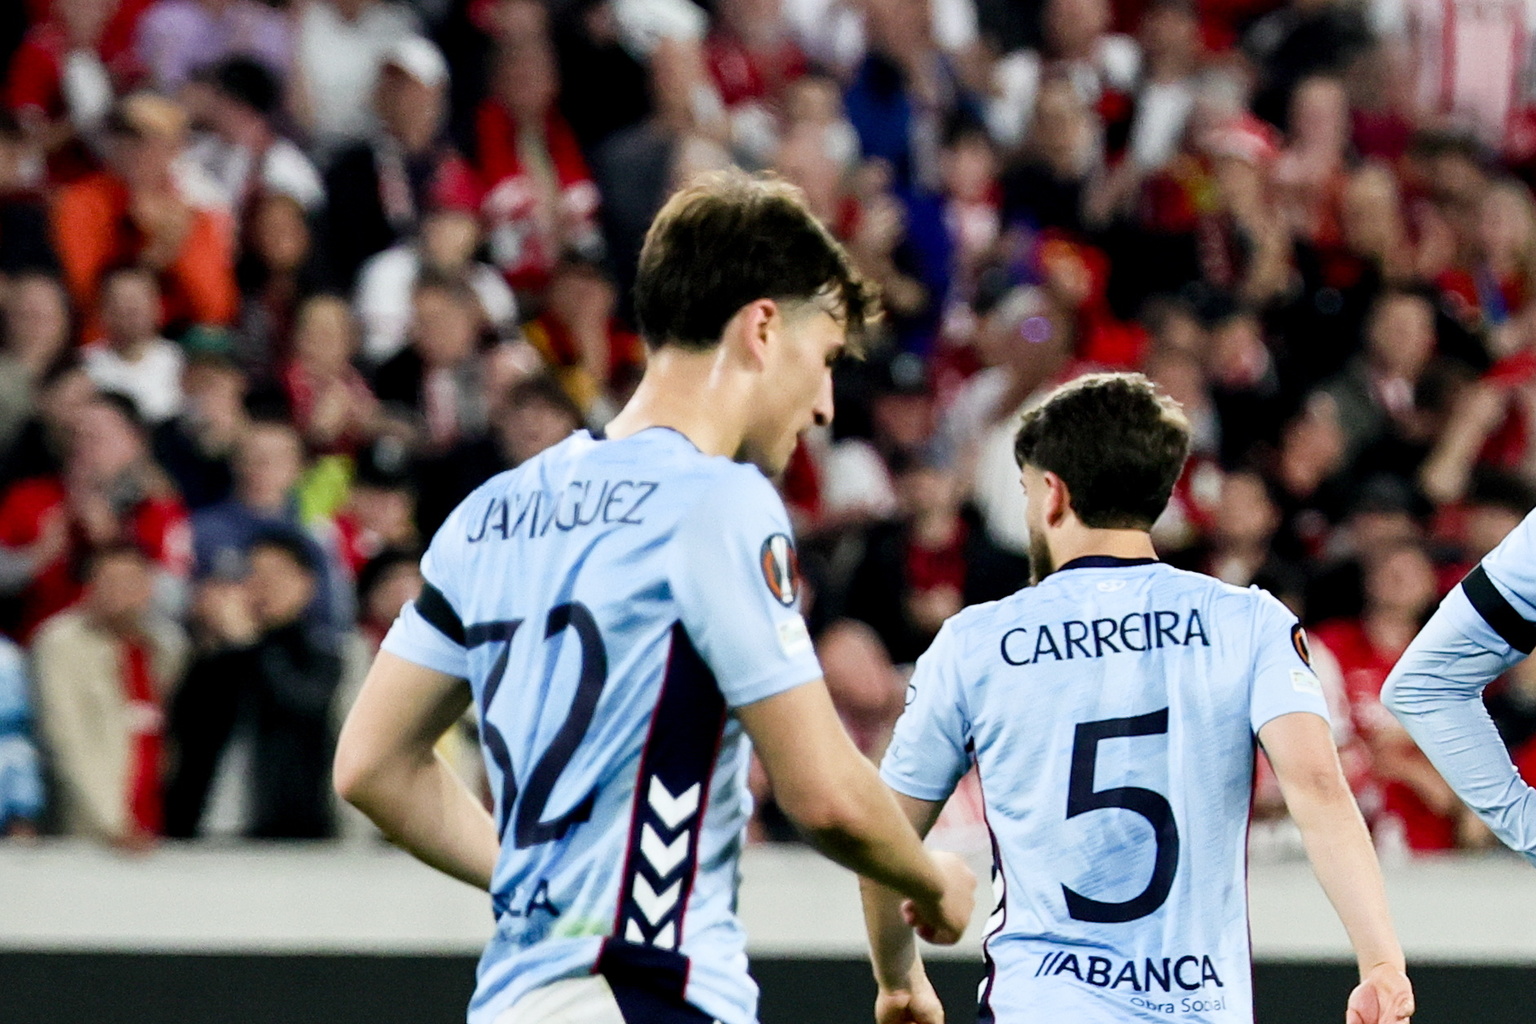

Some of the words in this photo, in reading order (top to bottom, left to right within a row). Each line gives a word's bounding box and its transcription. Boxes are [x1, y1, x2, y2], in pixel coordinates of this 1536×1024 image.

[465, 600, 609, 850] 32
[1000, 608, 1211, 667] CARREIRA
[1060, 706, 1180, 924] 5
